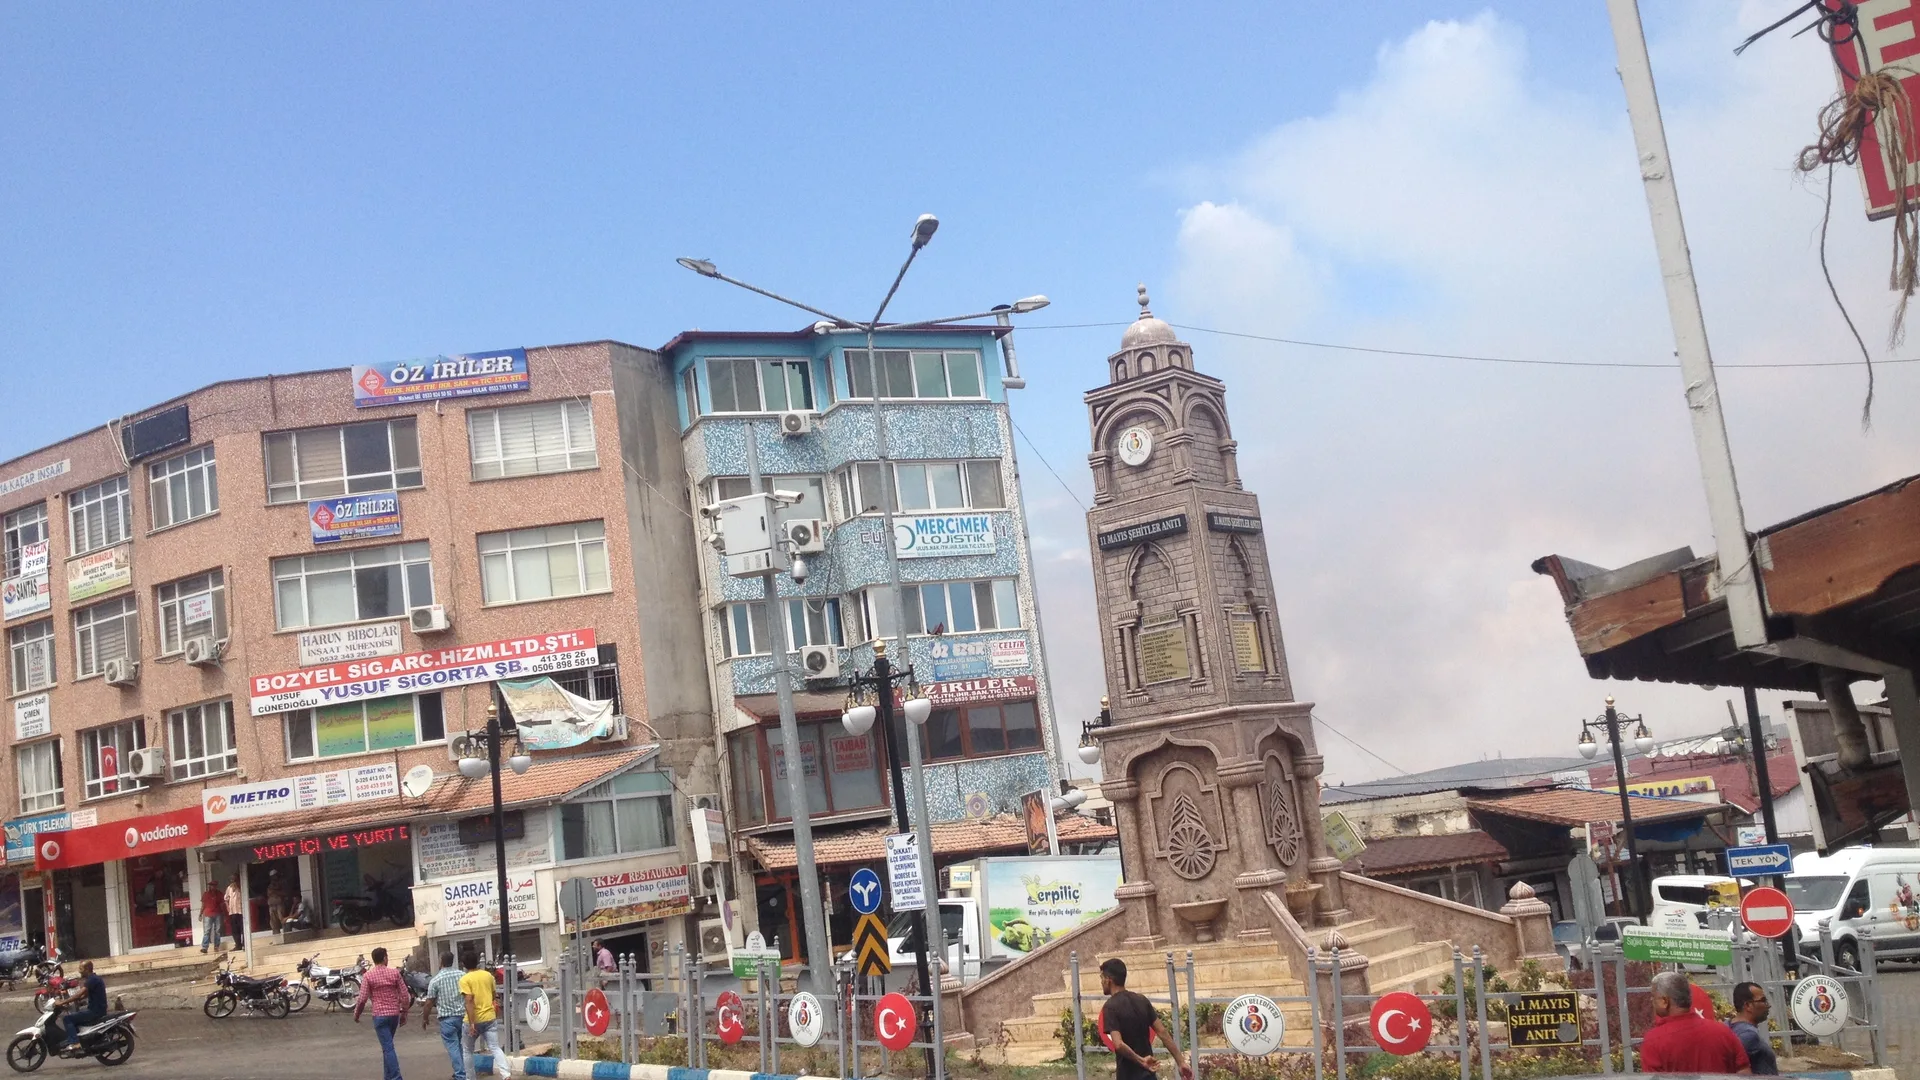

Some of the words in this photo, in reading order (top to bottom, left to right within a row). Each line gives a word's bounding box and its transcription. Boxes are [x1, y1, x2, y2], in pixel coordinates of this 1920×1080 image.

[390, 363, 426, 384] ÖZ
[431, 355, 513, 380] İRİLER
[336, 501, 353, 518] ÖZ
[356, 497, 395, 515] İRİLER
[1107, 531, 1128, 544] MAYIS
[1127, 523, 1161, 541] ŞEHİTLER
[302, 632, 342, 648] HARUN
[347, 625, 397, 641] BİBOLAR
[540, 654, 558, 663] 413
[560, 652, 572, 660] 26
[575, 650, 586, 659] 26
[532, 662, 553, 673] 0506
[556, 660, 573, 669] 898
[575, 657, 596, 667] 5819
[256, 667, 342, 692] BOZYEL
[270, 692, 301, 702] YUSUF
[320, 679, 391, 700] YUSUF
[17, 699, 34, 709] Ahmet
[230, 787, 290, 805] METRO
[18, 822, 38, 835] TÜRK
[141, 823, 188, 842] vodafone
[254, 843, 296, 861] YURT
[300, 837, 321, 855] İÇİ
[327, 835, 349, 850] VE
[352, 828, 396, 847] YURT
[1735, 857, 1754, 866] TEK
[1759, 854, 1779, 864] YÖN
[629, 866, 683, 882] RESTAURANT
[445, 881, 493, 900] SARRAF
[629, 882, 654, 894] Kebap
[656, 878, 687, 890] Çeşitleri
[513, 894, 535, 903] ÖDEME
[518, 910, 535, 918] LOTO
[1529, 998, 1570, 1010] MAYIS
[1511, 1012, 1576, 1029] ŞEHİTLER
